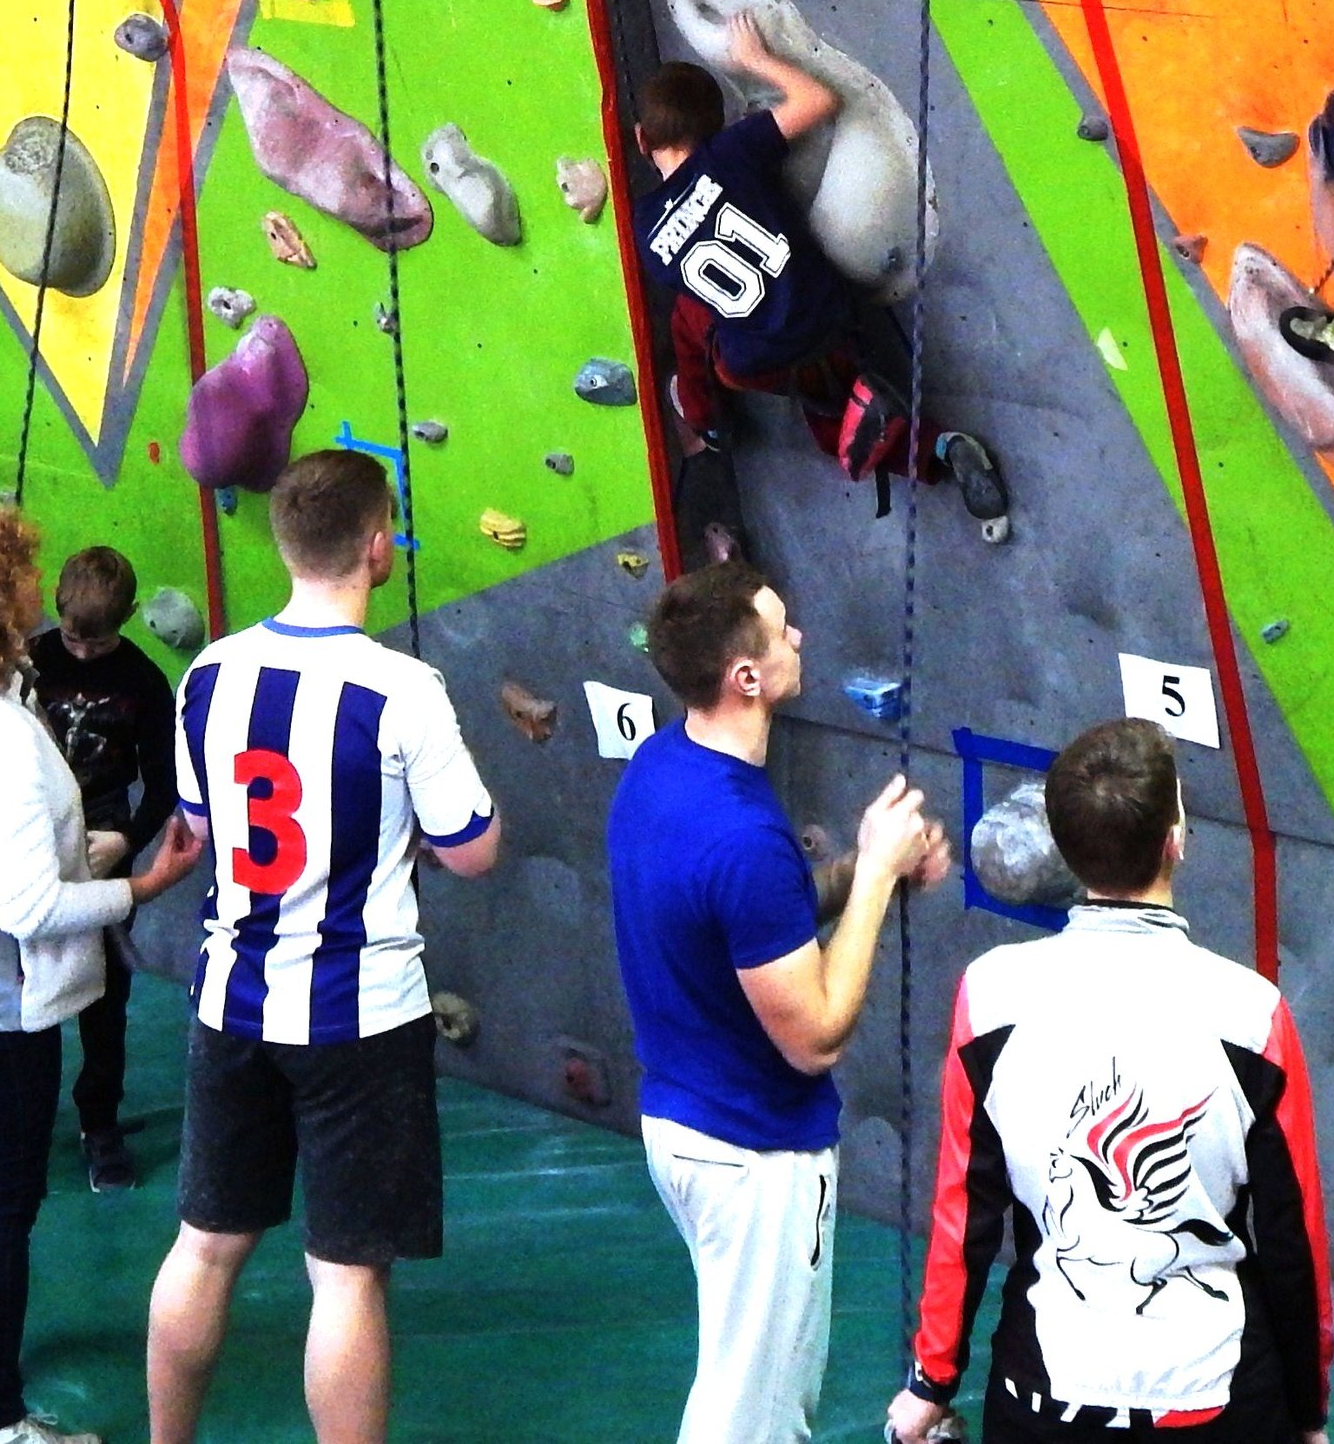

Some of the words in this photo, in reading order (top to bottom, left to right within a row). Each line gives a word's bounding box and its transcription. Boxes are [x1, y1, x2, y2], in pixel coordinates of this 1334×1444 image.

[680, 202, 791, 318] 01
[617, 703, 636, 741] 6
[1162, 675, 1186, 717] 5
[232, 749, 307, 895] 3
